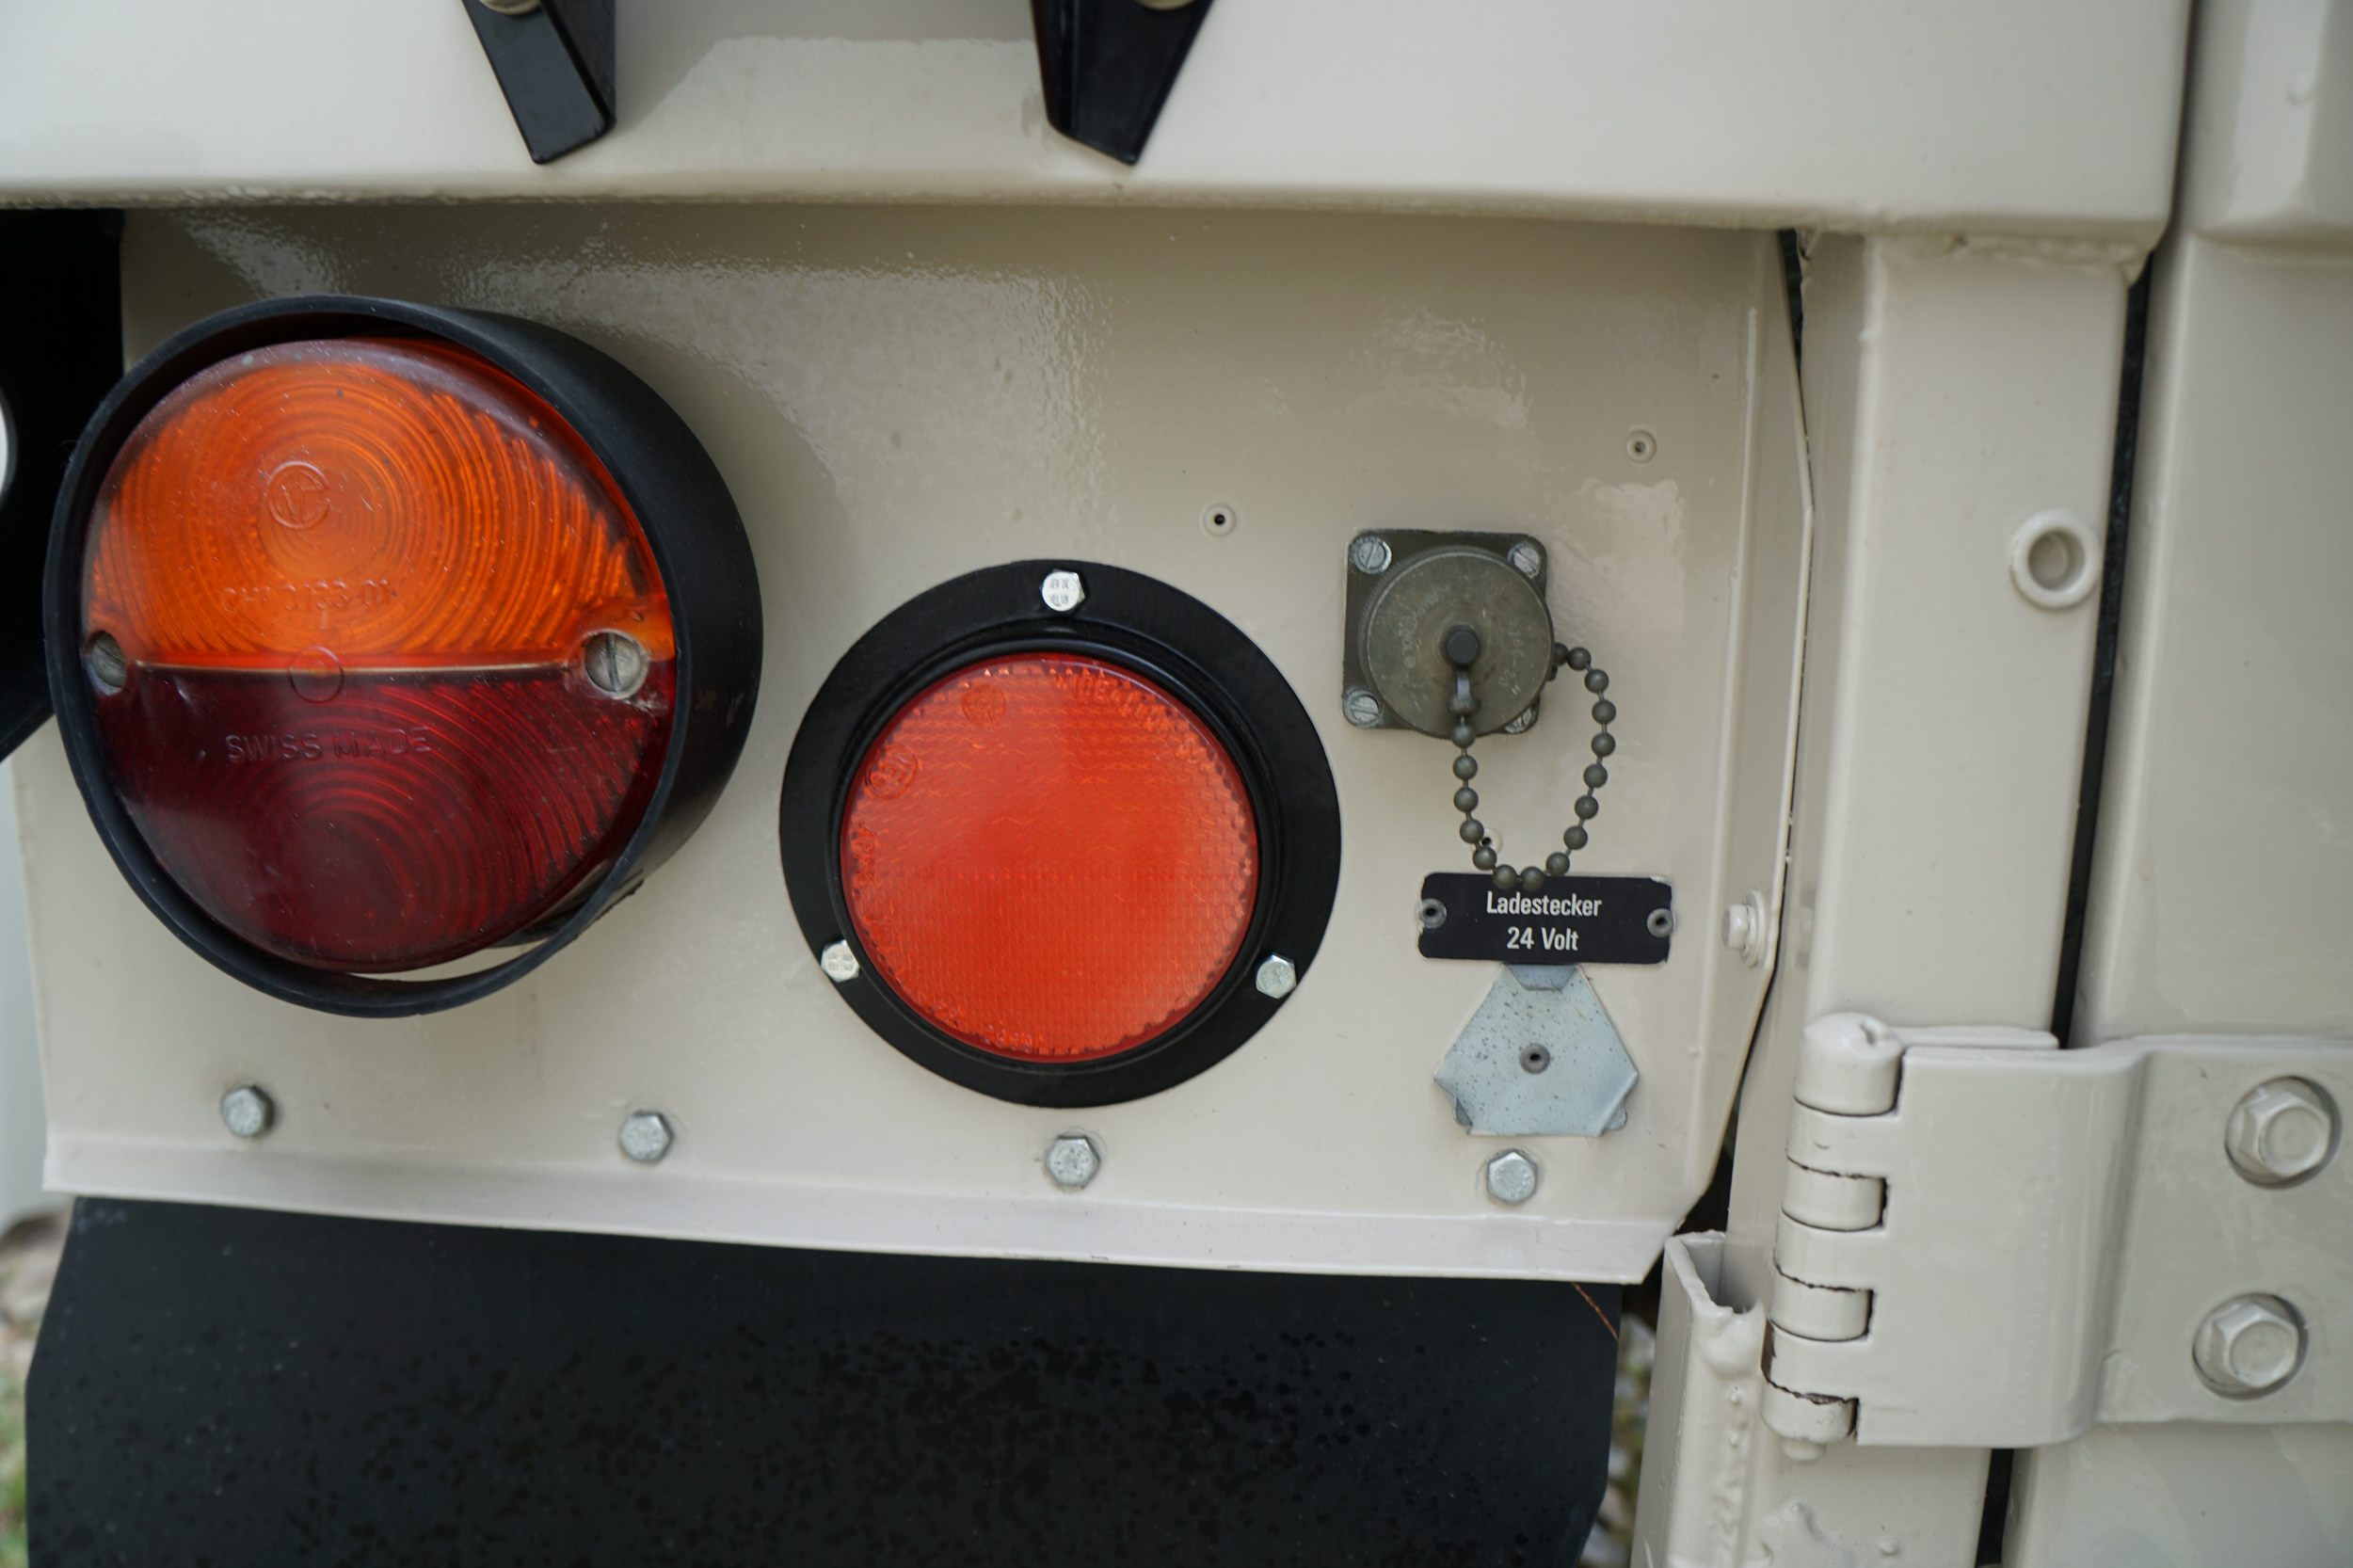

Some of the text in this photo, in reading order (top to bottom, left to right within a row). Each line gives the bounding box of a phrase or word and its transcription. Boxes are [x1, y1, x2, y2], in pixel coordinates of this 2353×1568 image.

[225, 727, 431, 761] SWISS MADE
[1486, 890, 1603, 917] Ladestecker
[1506, 926, 1579, 951] 24 Volt
